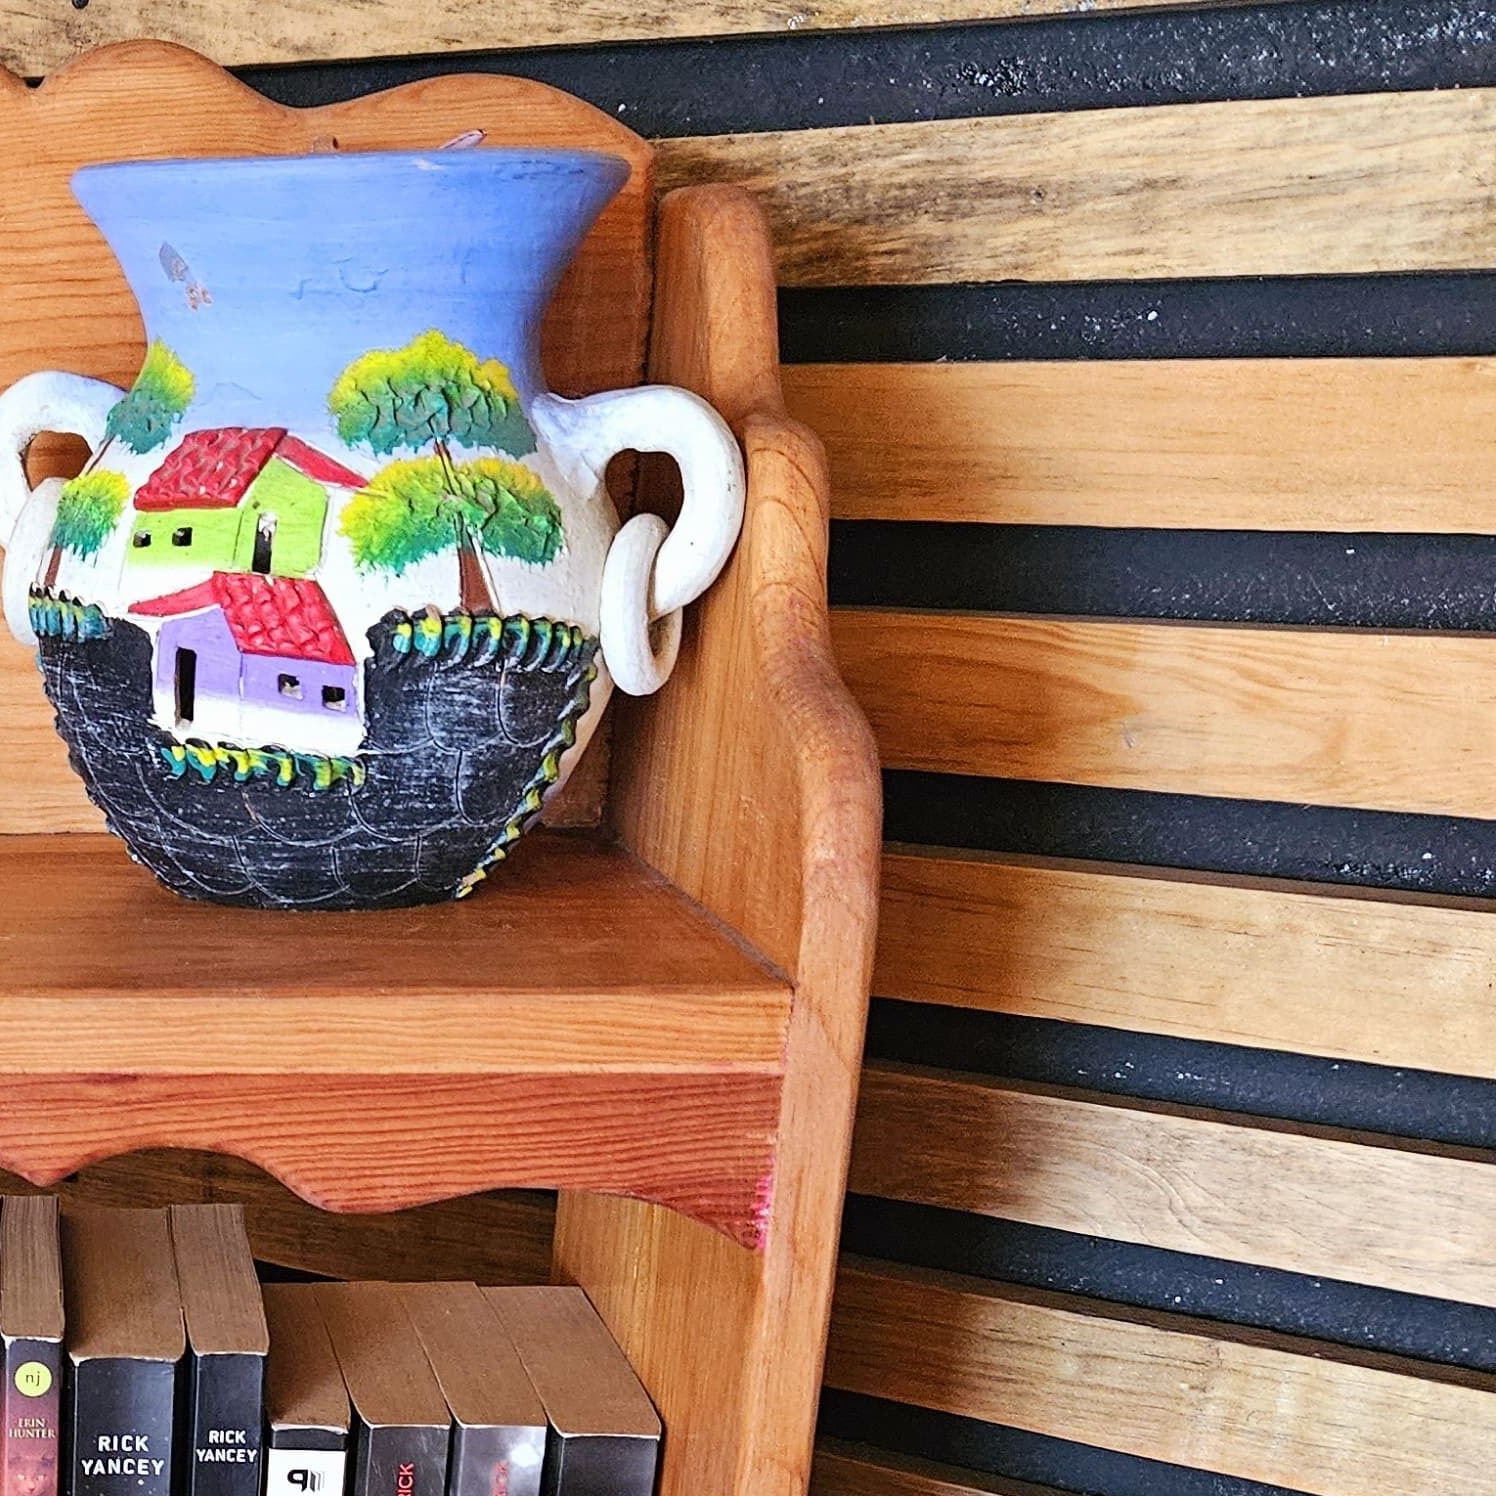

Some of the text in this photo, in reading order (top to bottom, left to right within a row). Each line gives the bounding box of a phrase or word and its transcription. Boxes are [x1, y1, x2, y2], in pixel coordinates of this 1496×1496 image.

[26, 1371, 41, 1386] nj
[19, 1418, 45, 1428] ERIN
[9, 1428, 56, 1438] HUNTER
[209, 1431, 245, 1443] RICK
[98, 1436, 148, 1451] RICK
[196, 1449, 257, 1462] YANCEY
[82, 1459, 164, 1475] YANCEY
